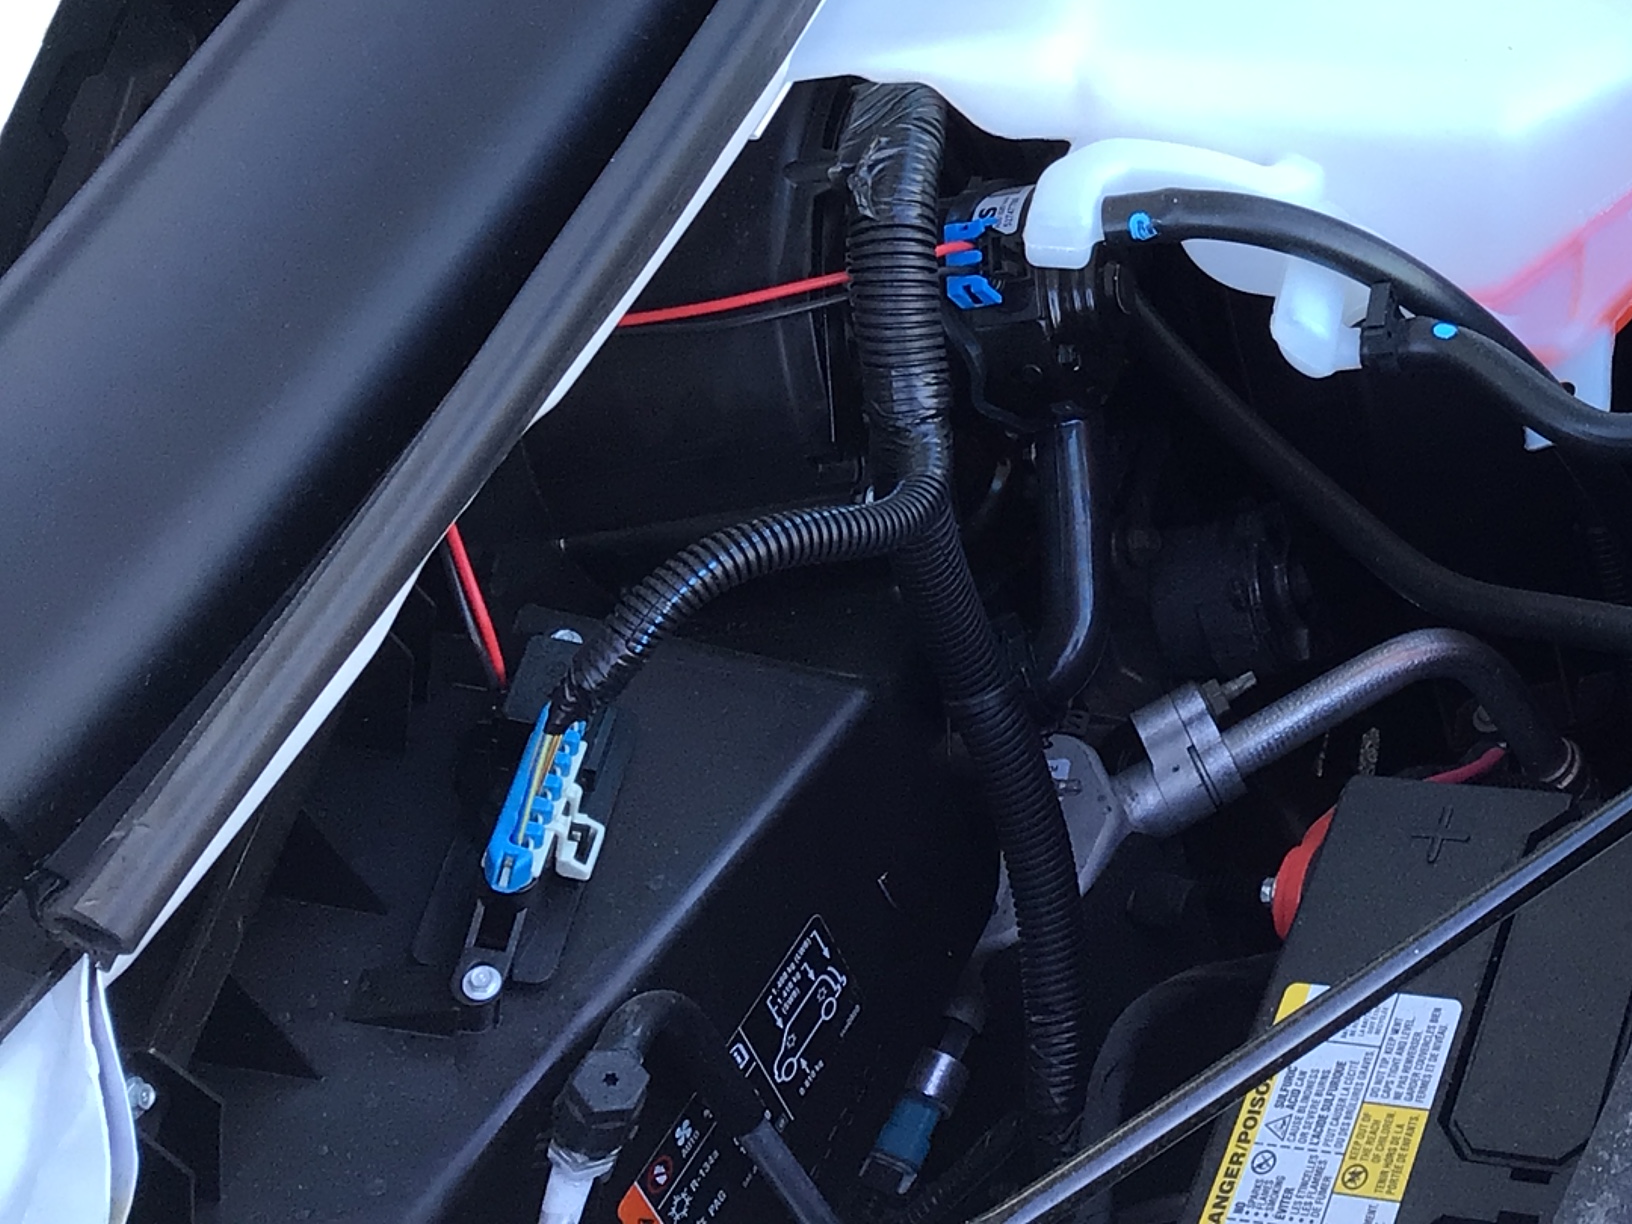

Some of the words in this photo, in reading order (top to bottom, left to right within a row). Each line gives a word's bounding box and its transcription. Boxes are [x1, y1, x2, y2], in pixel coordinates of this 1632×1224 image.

[1383, 1037, 1397, 1053] KEEP
[1274, 1065, 1298, 1108] SULFURIC
[1285, 1089, 1301, 1109] ACID
[1293, 1070, 1308, 1086] CAN
[1320, 1061, 1347, 1111] SULFURIQUE
[1396, 1074, 1408, 1088] PAS
[1302, 1099, 1321, 1129] SEVERE
[1327, 1097, 1347, 1126] CAUSER
[1339, 1087, 1350, 1095] LA
[1286, 1115, 1303, 1141] CAUSE
[1297, 1131, 1309, 1143] OR
[1347, 1140, 1362, 1160] KEEP
[1355, 1124, 1368, 1139] OUT
[1365, 1119, 1381, 1144] REACH
[1393, 1123, 1406, 1134] LA
[680, 1129, 700, 1159] AUTO
[1207, 1079, 1271, 1224] ANGER/POISO
[689, 1147, 718, 1192] R-134a
